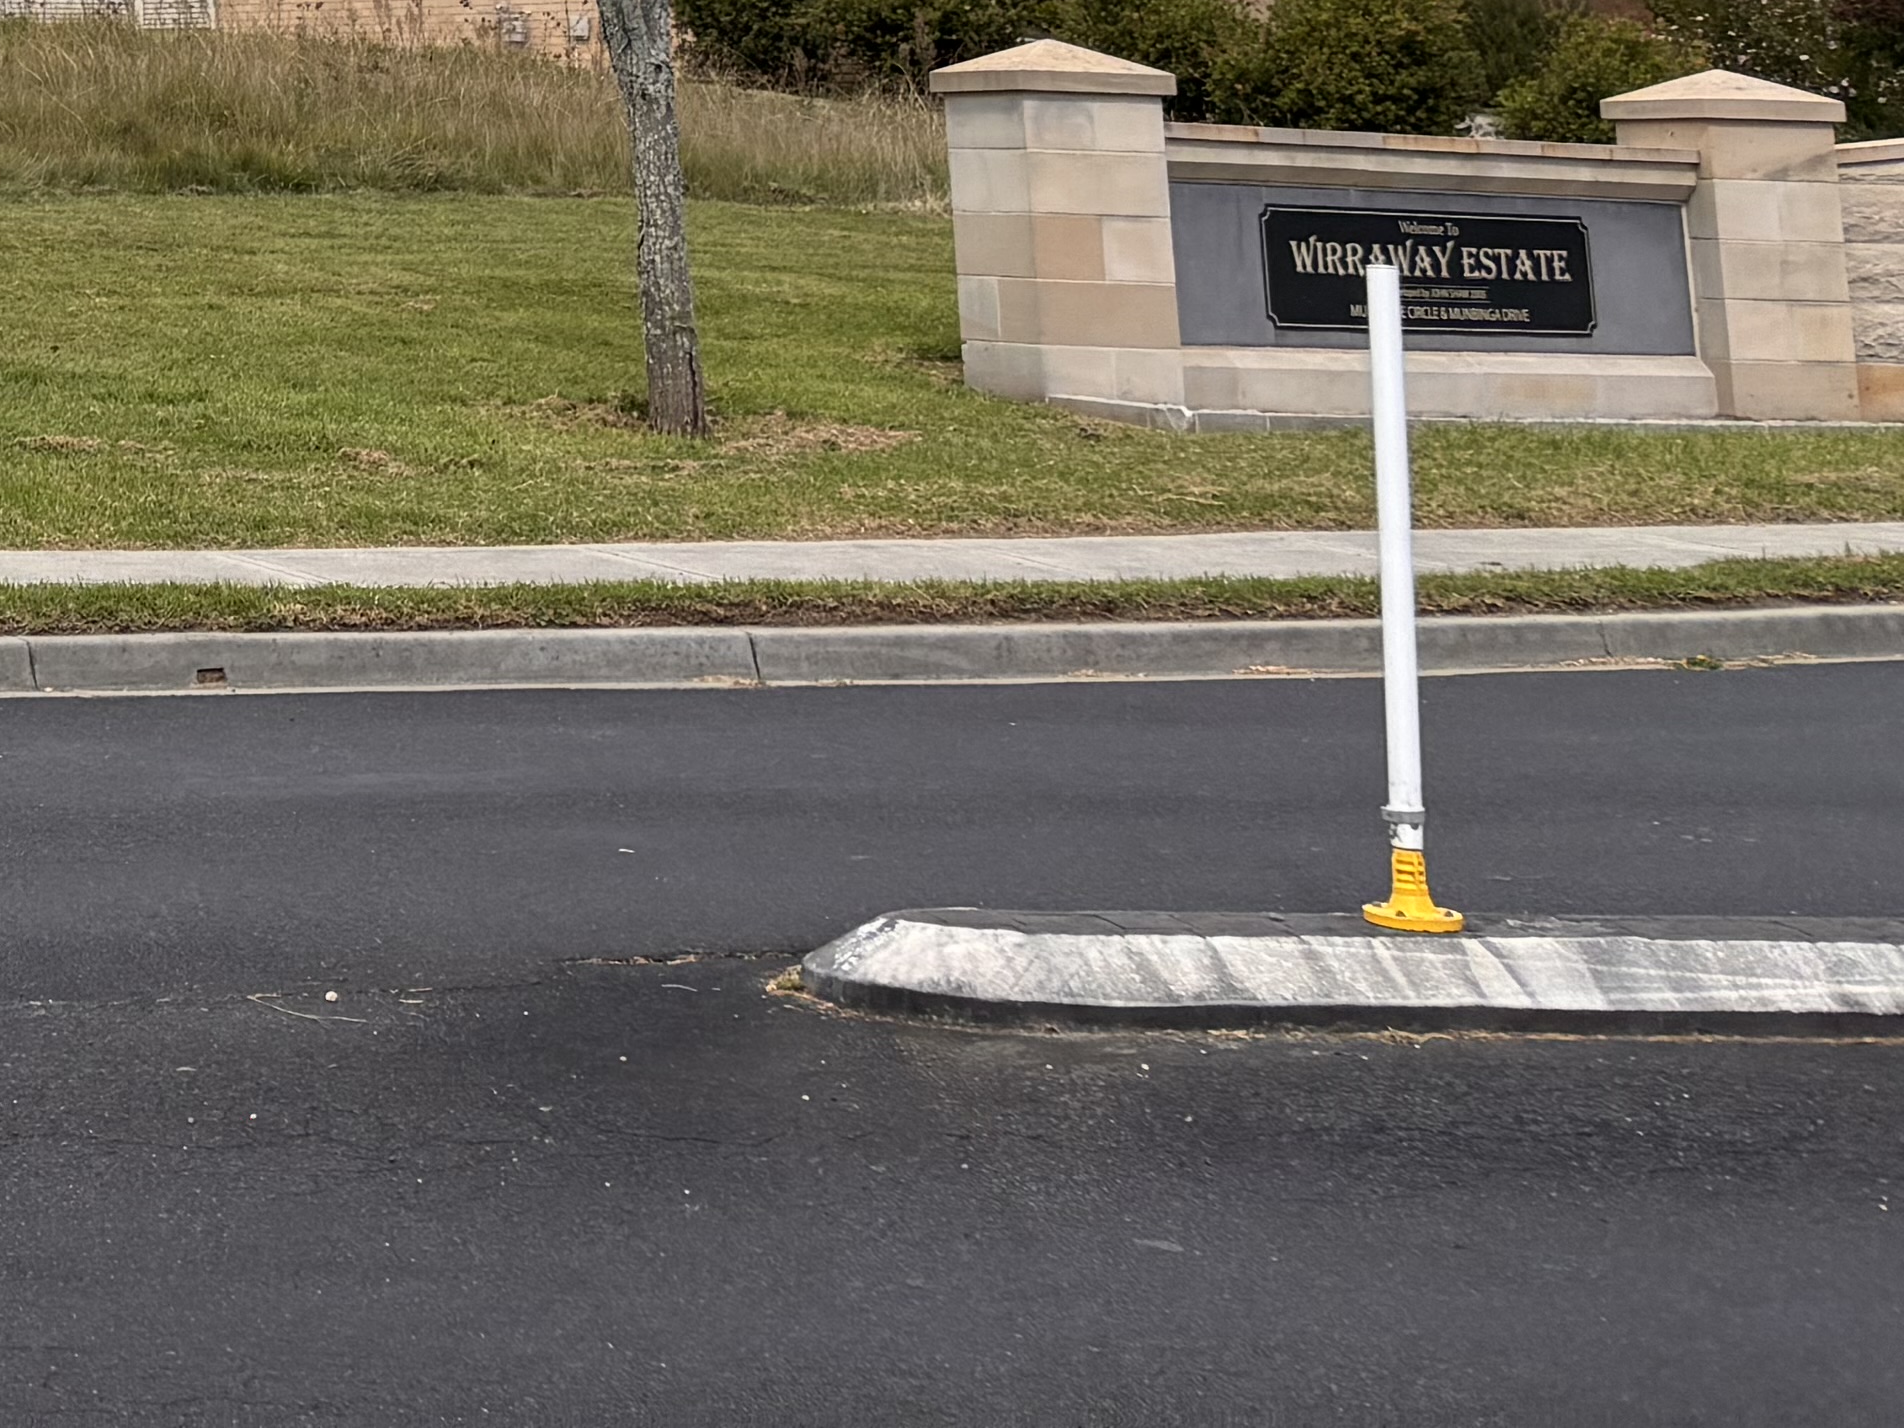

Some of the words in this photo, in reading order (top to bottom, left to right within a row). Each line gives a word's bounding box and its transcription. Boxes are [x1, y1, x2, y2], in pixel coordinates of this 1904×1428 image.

[1398, 220, 1444, 235] Welcome
[1445, 222, 1460, 236] To
[1461, 247, 1573, 282] ESTATE
[1407, 306, 1440, 319] CIRCLE
[1502, 307, 1531, 322] DRIVE
